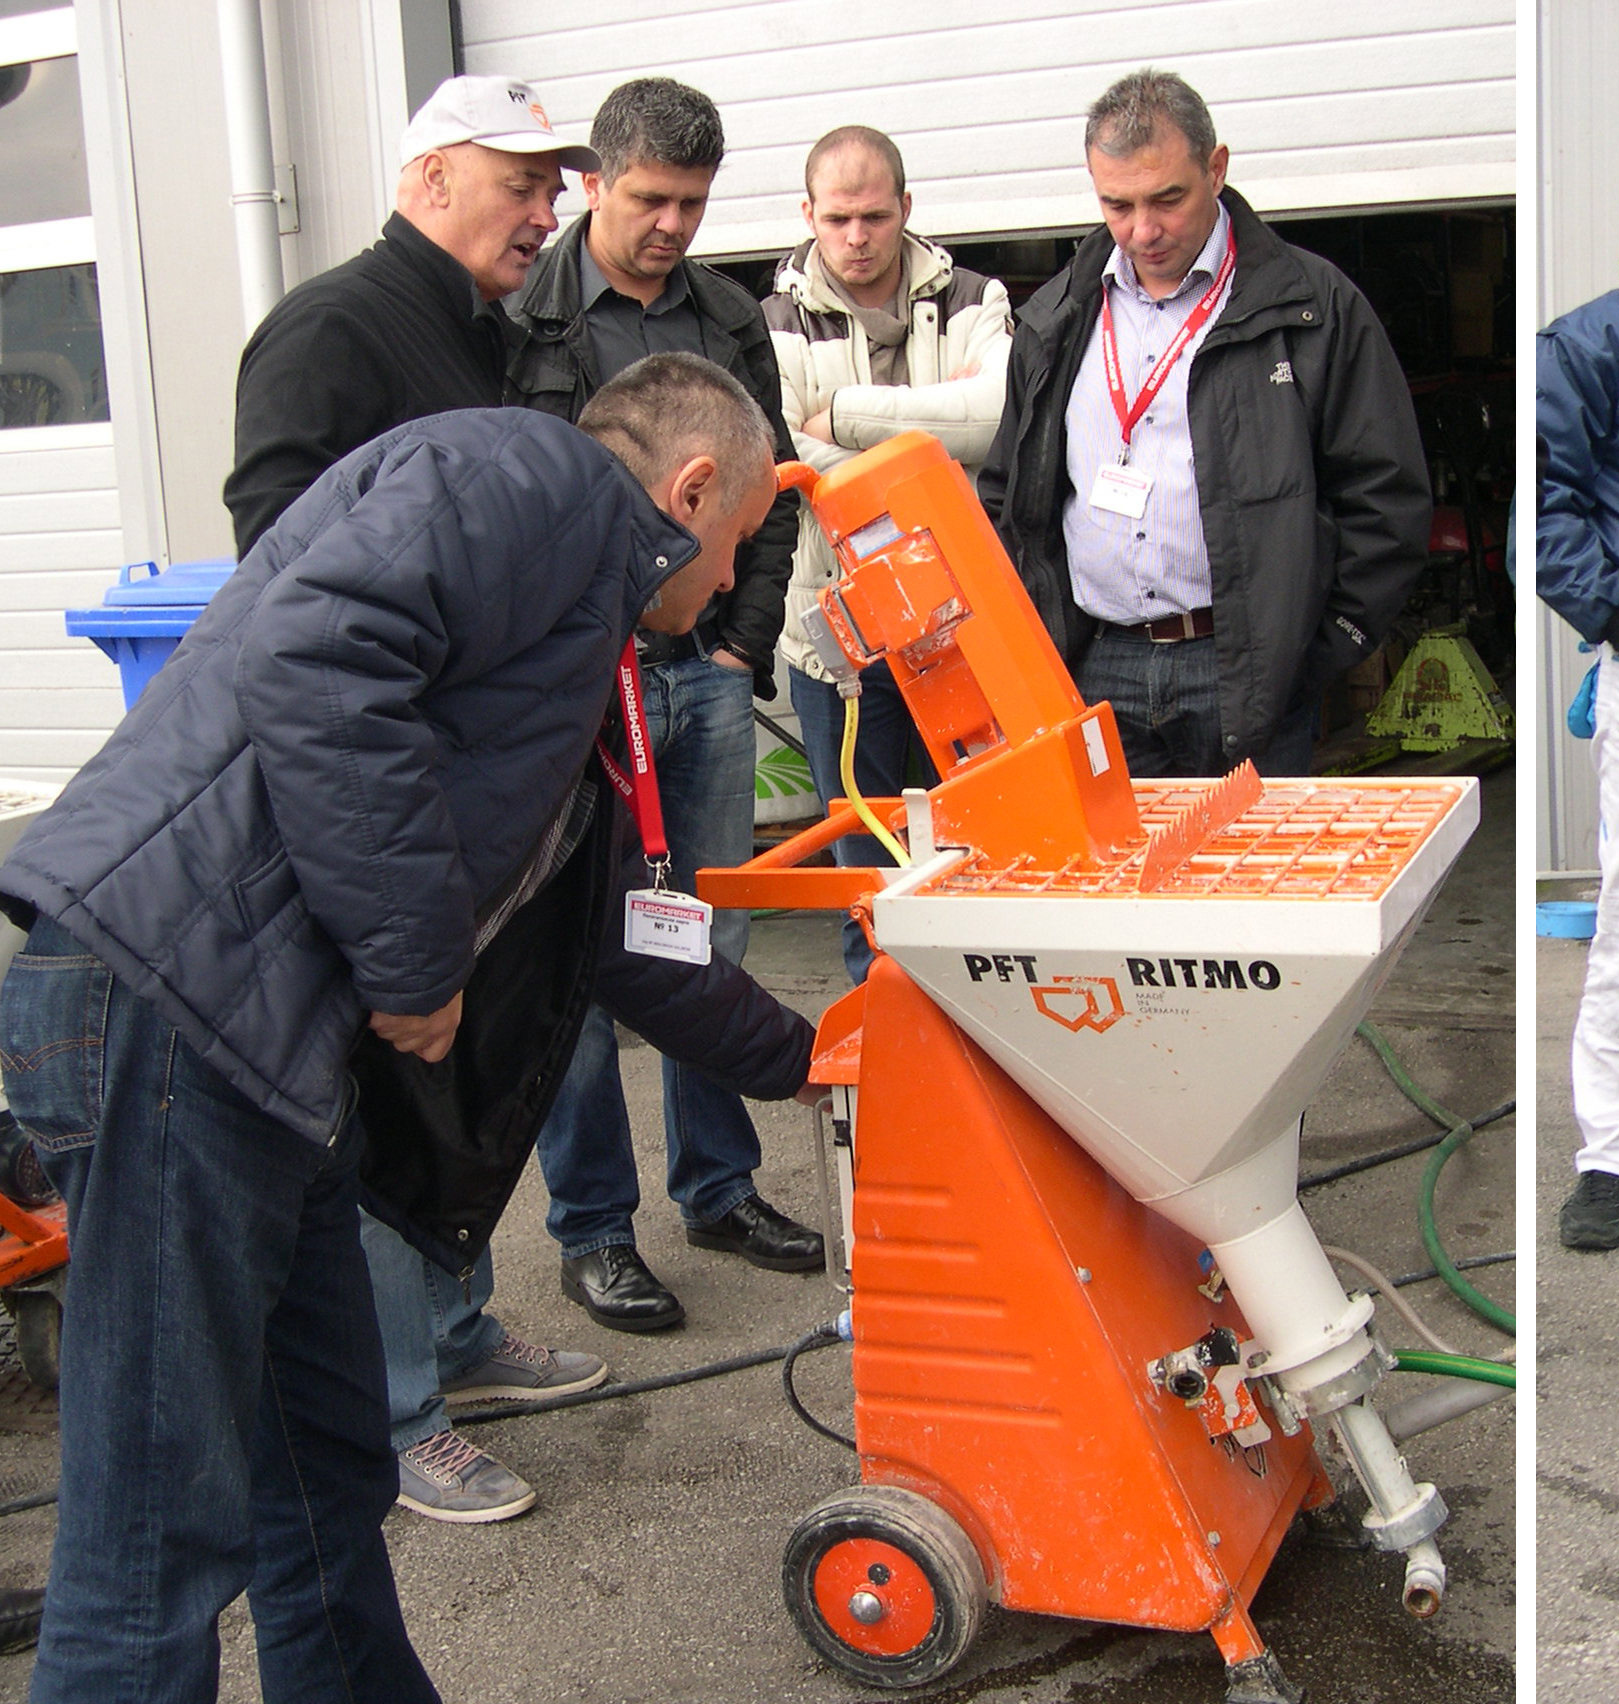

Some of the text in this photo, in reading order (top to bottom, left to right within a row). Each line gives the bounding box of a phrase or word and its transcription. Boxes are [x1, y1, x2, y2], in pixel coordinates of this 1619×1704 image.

[620, 665, 648, 775] EUROMARKET
[633, 902, 702, 921] EUROMARKET
[668, 924, 679, 933] 13
[963, 954, 1282, 991] PFT RITMO
